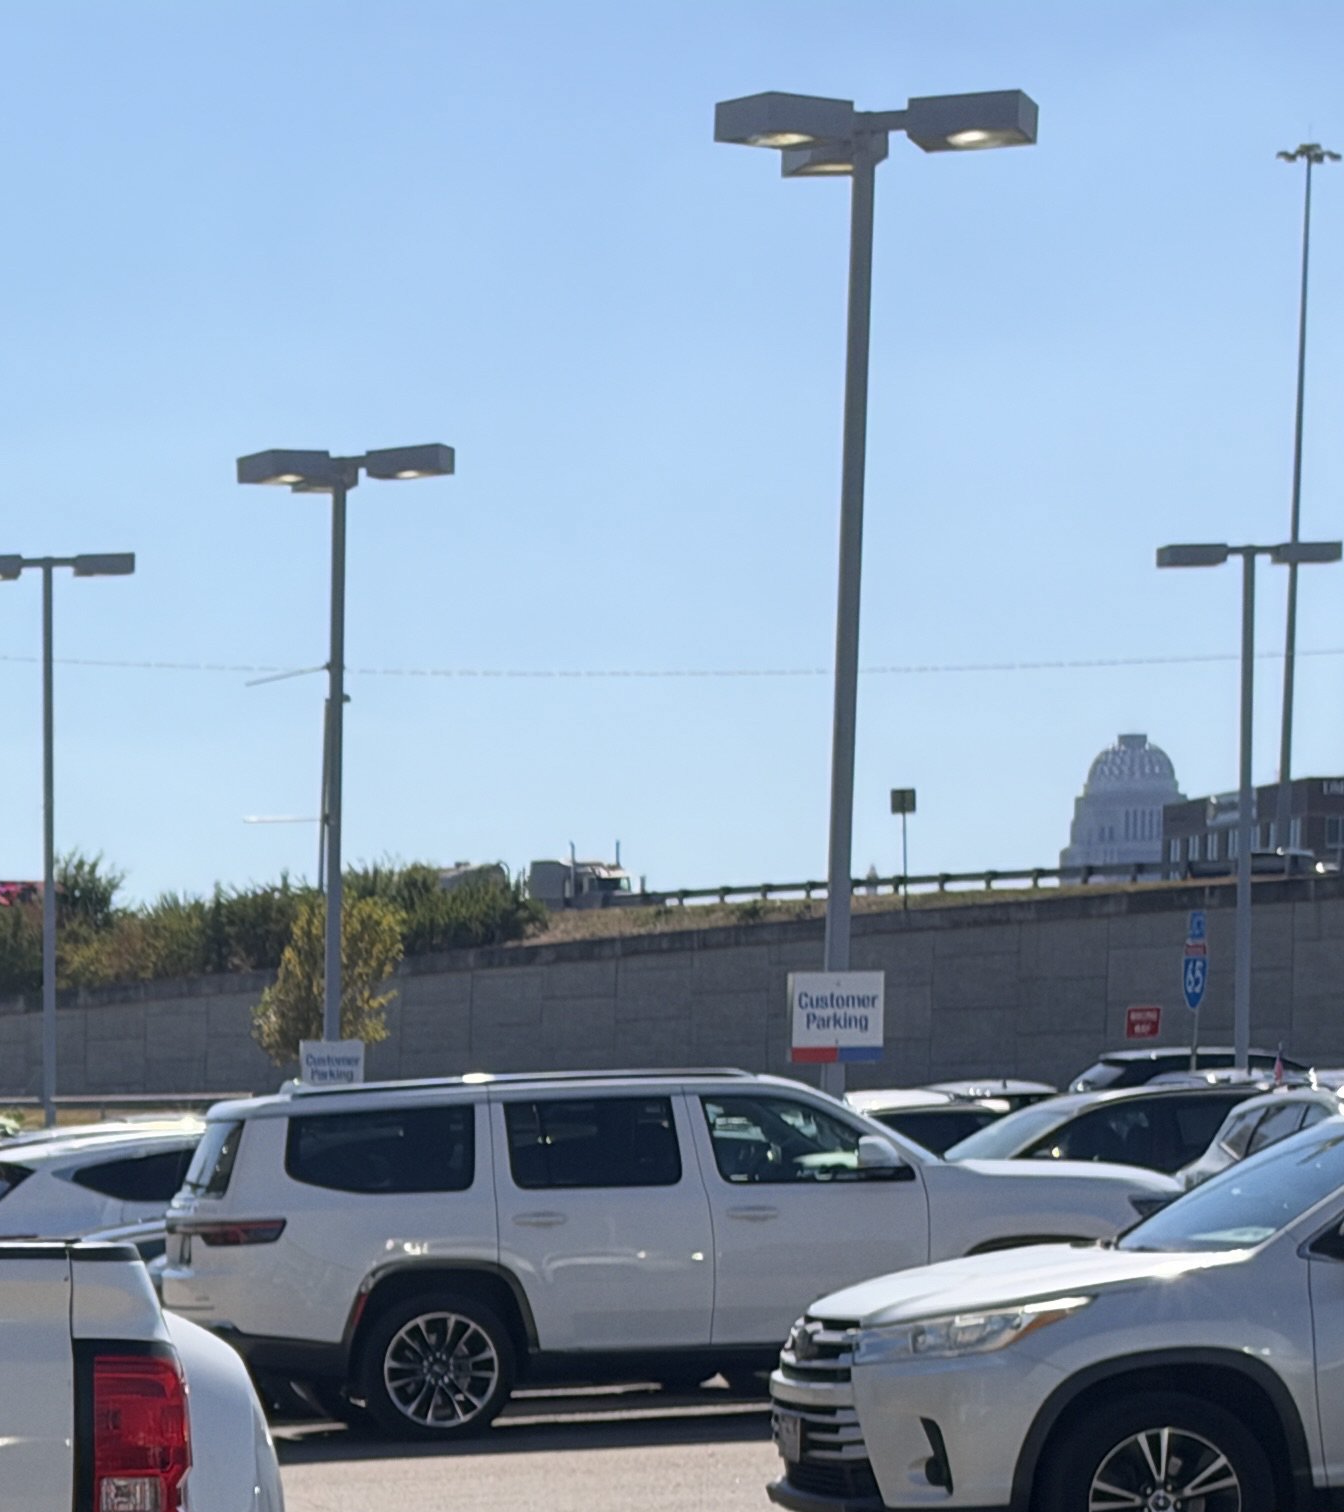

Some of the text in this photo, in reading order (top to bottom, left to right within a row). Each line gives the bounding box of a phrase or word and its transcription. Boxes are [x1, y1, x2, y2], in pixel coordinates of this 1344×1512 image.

[1186, 959, 1204, 993] 65
[798, 992, 878, 1009] Customer
[806, 1011, 869, 1032] Parking
[306, 1053, 360, 1067] Customer
